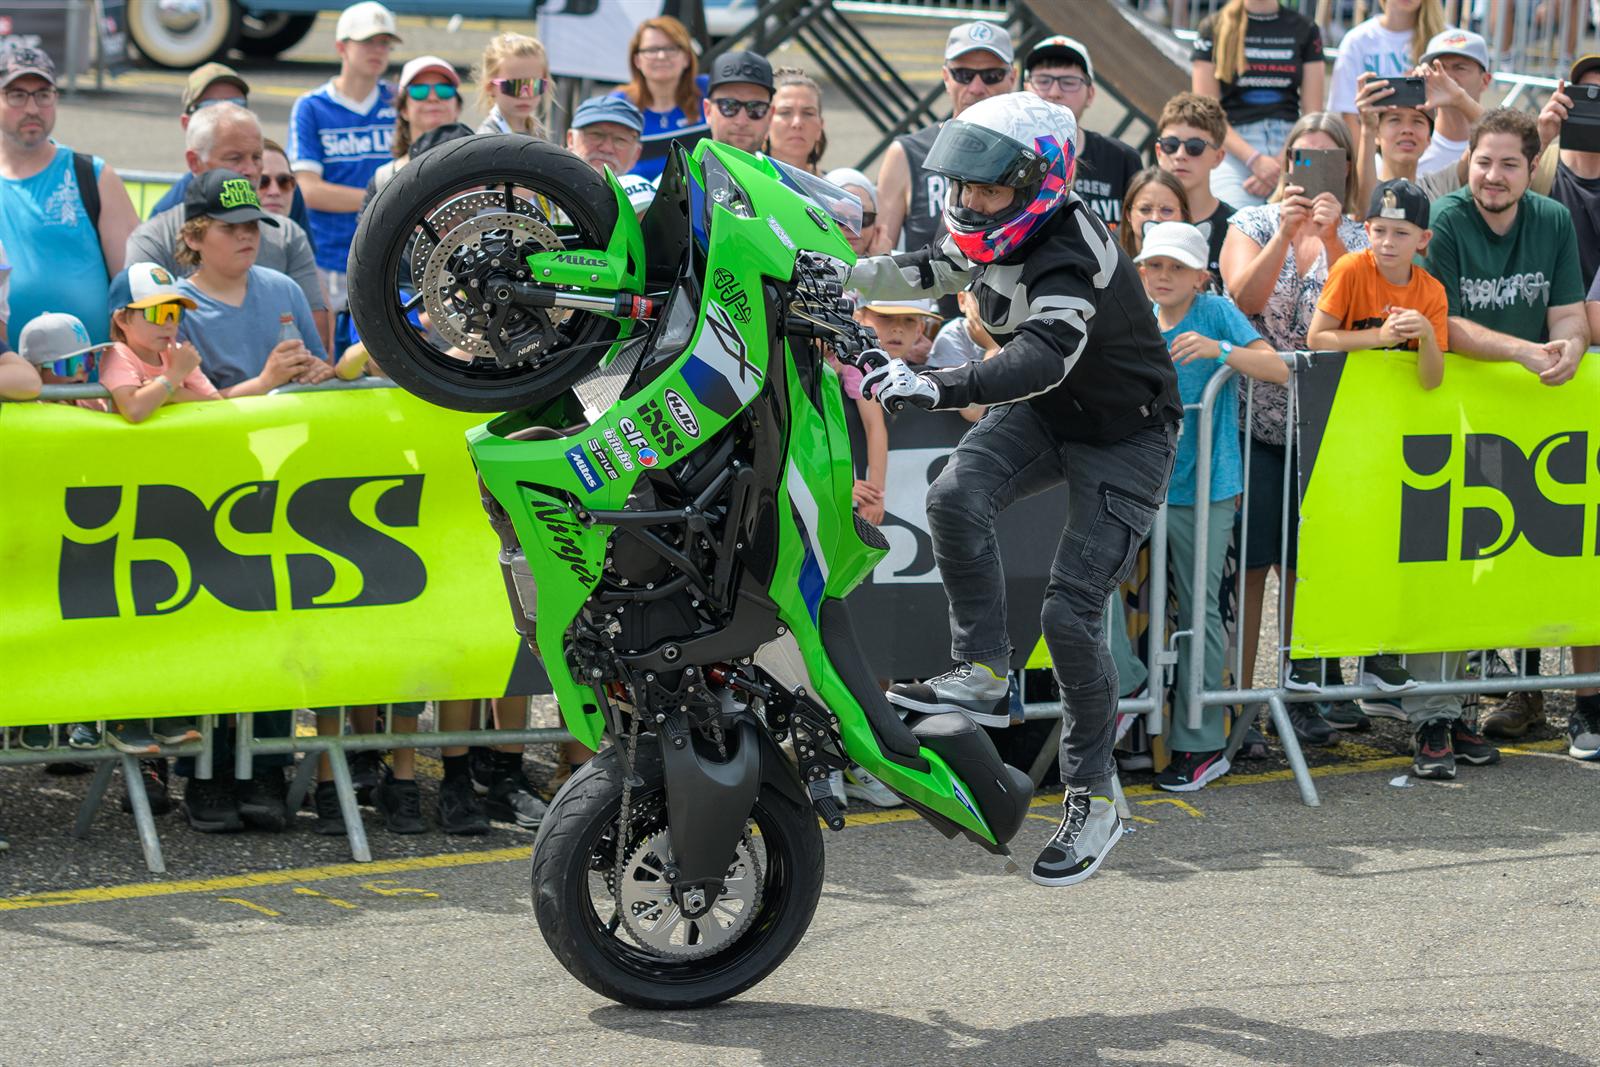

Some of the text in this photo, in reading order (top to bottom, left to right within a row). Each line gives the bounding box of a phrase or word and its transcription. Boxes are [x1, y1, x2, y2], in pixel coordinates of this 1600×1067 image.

[1075, 180, 1111, 197] CREW
[551, 254, 608, 267] Mitas
[705, 305, 763, 385] ZX
[667, 396, 698, 432] HJC
[602, 427, 635, 472] bitubo
[570, 452, 597, 488] Mitas
[531, 501, 601, 589] Ninja
